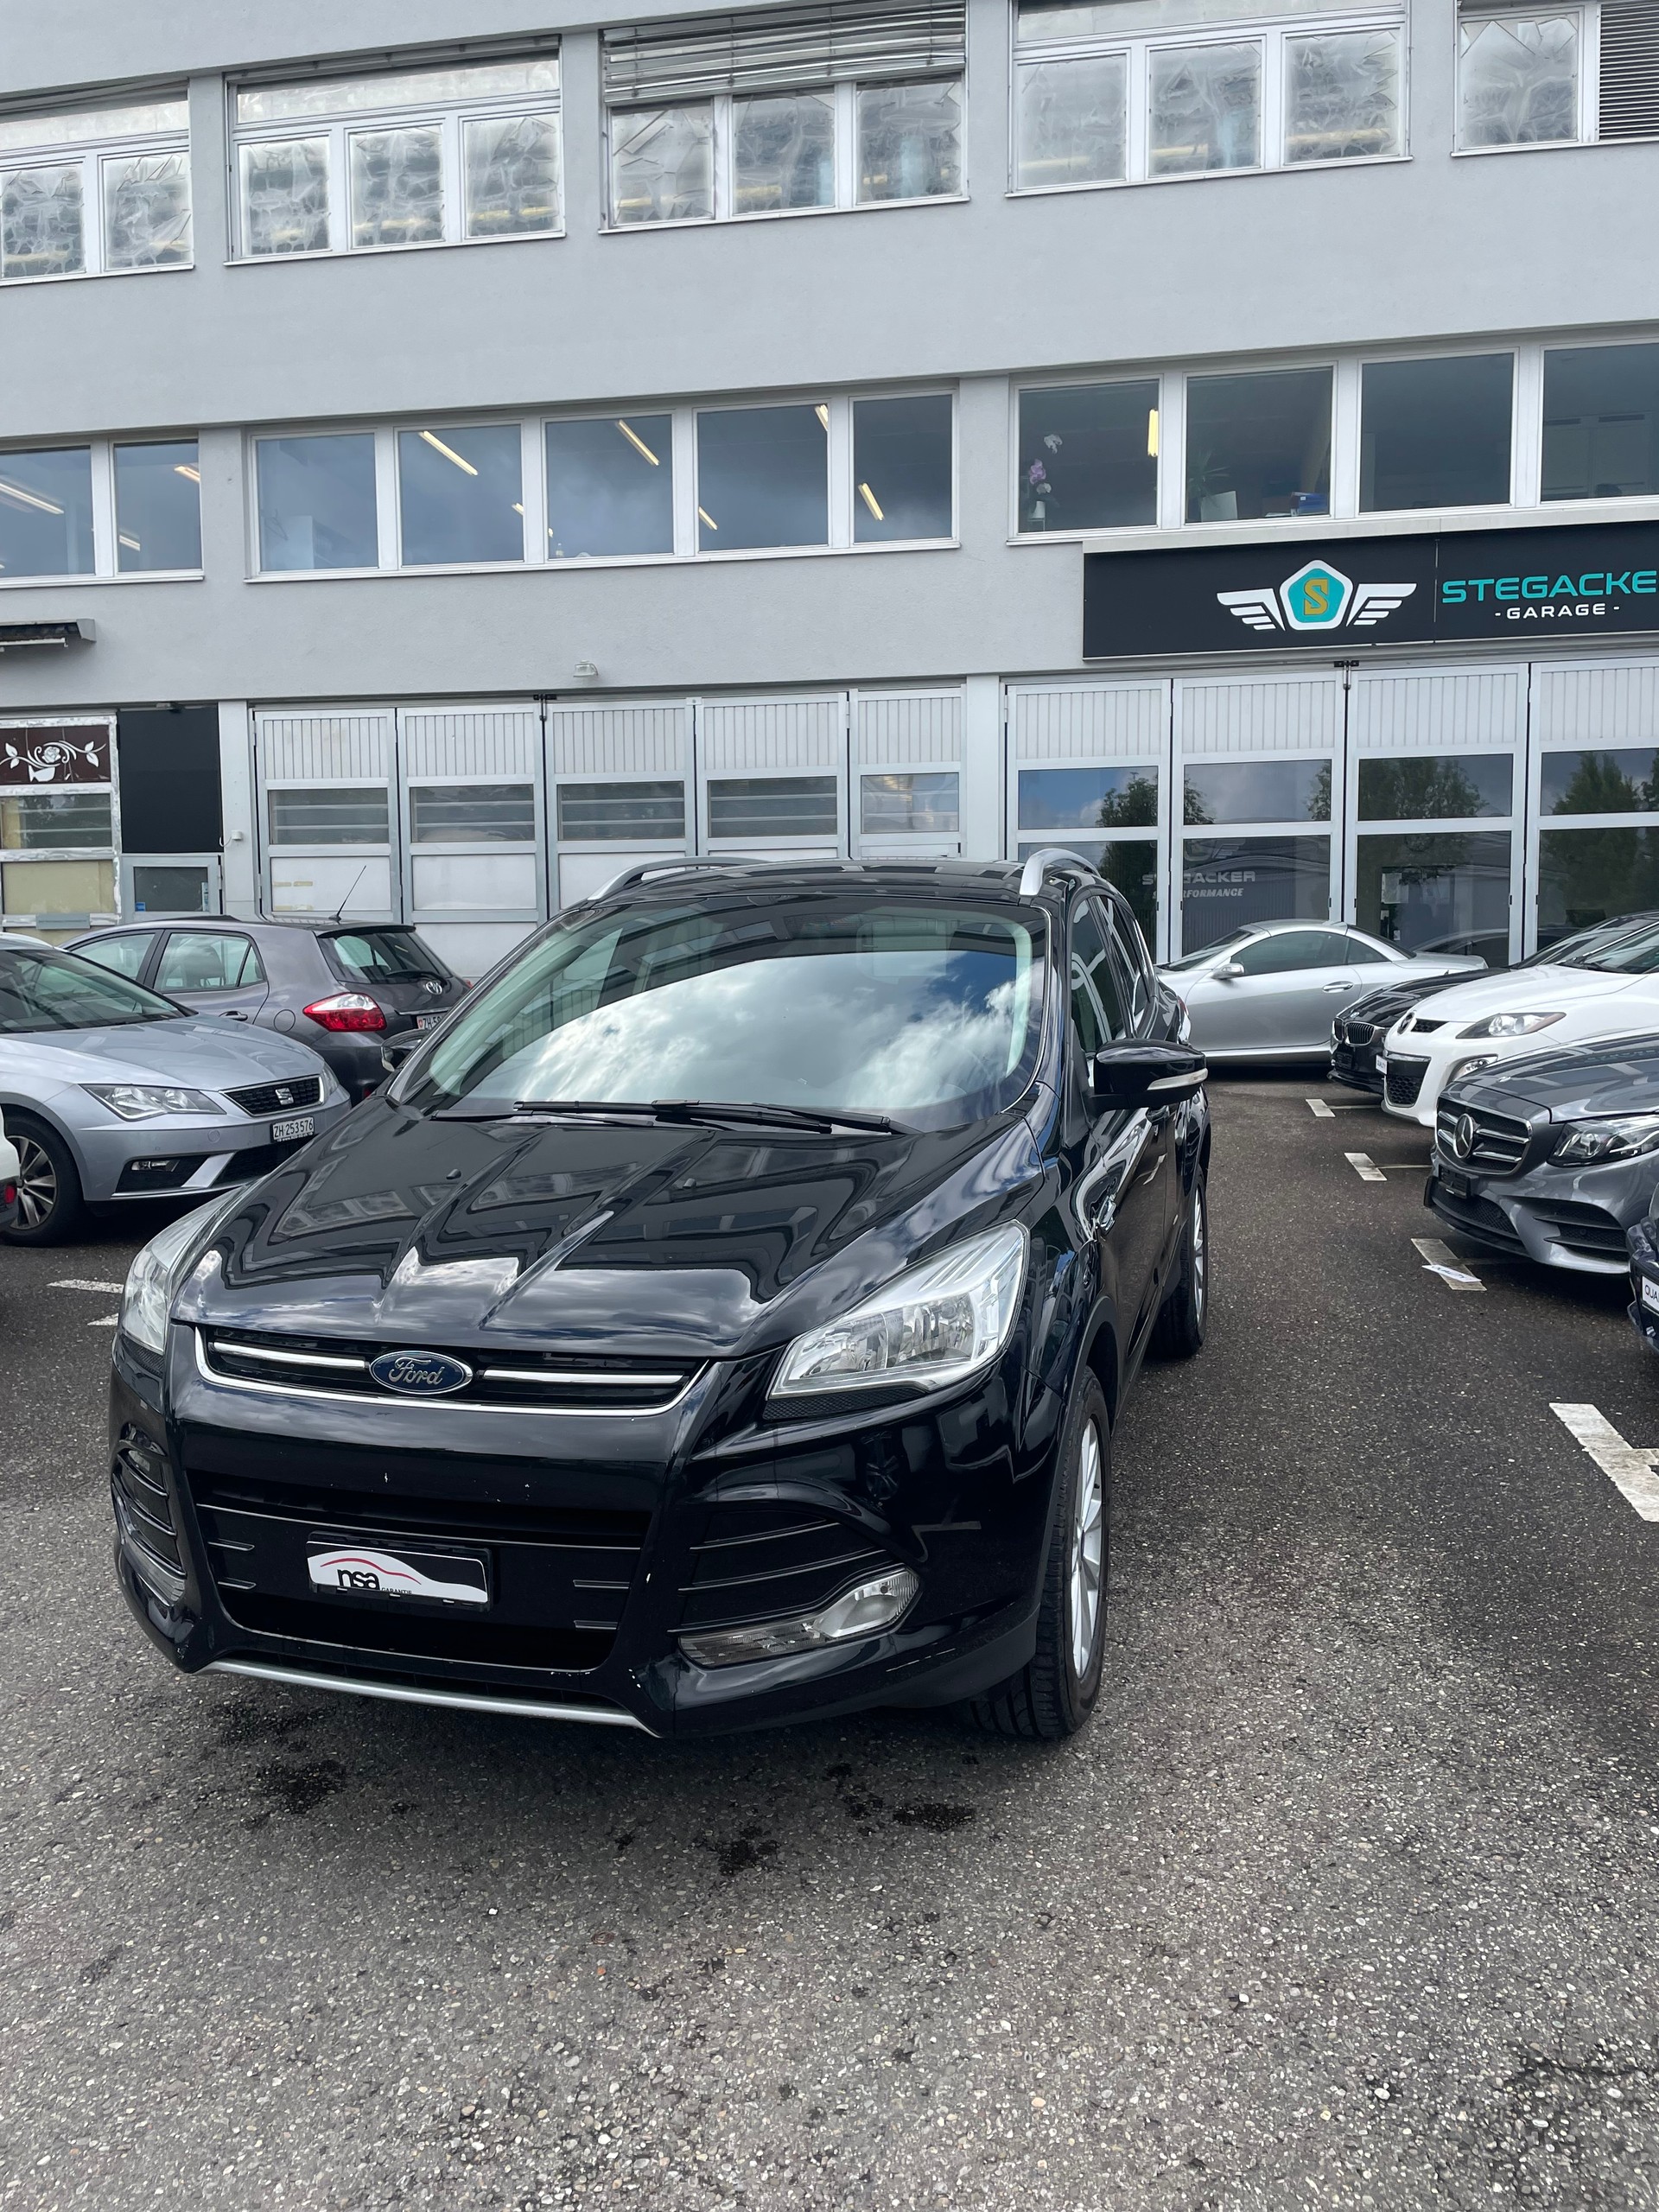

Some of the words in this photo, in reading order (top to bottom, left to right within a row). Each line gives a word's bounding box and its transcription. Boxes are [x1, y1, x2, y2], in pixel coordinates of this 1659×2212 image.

[1304, 578, 1328, 615] S
[1442, 570, 1658, 603] STEGACKE
[388, 1357, 446, 1385] Ford
[336, 1568, 381, 1591] nsa
